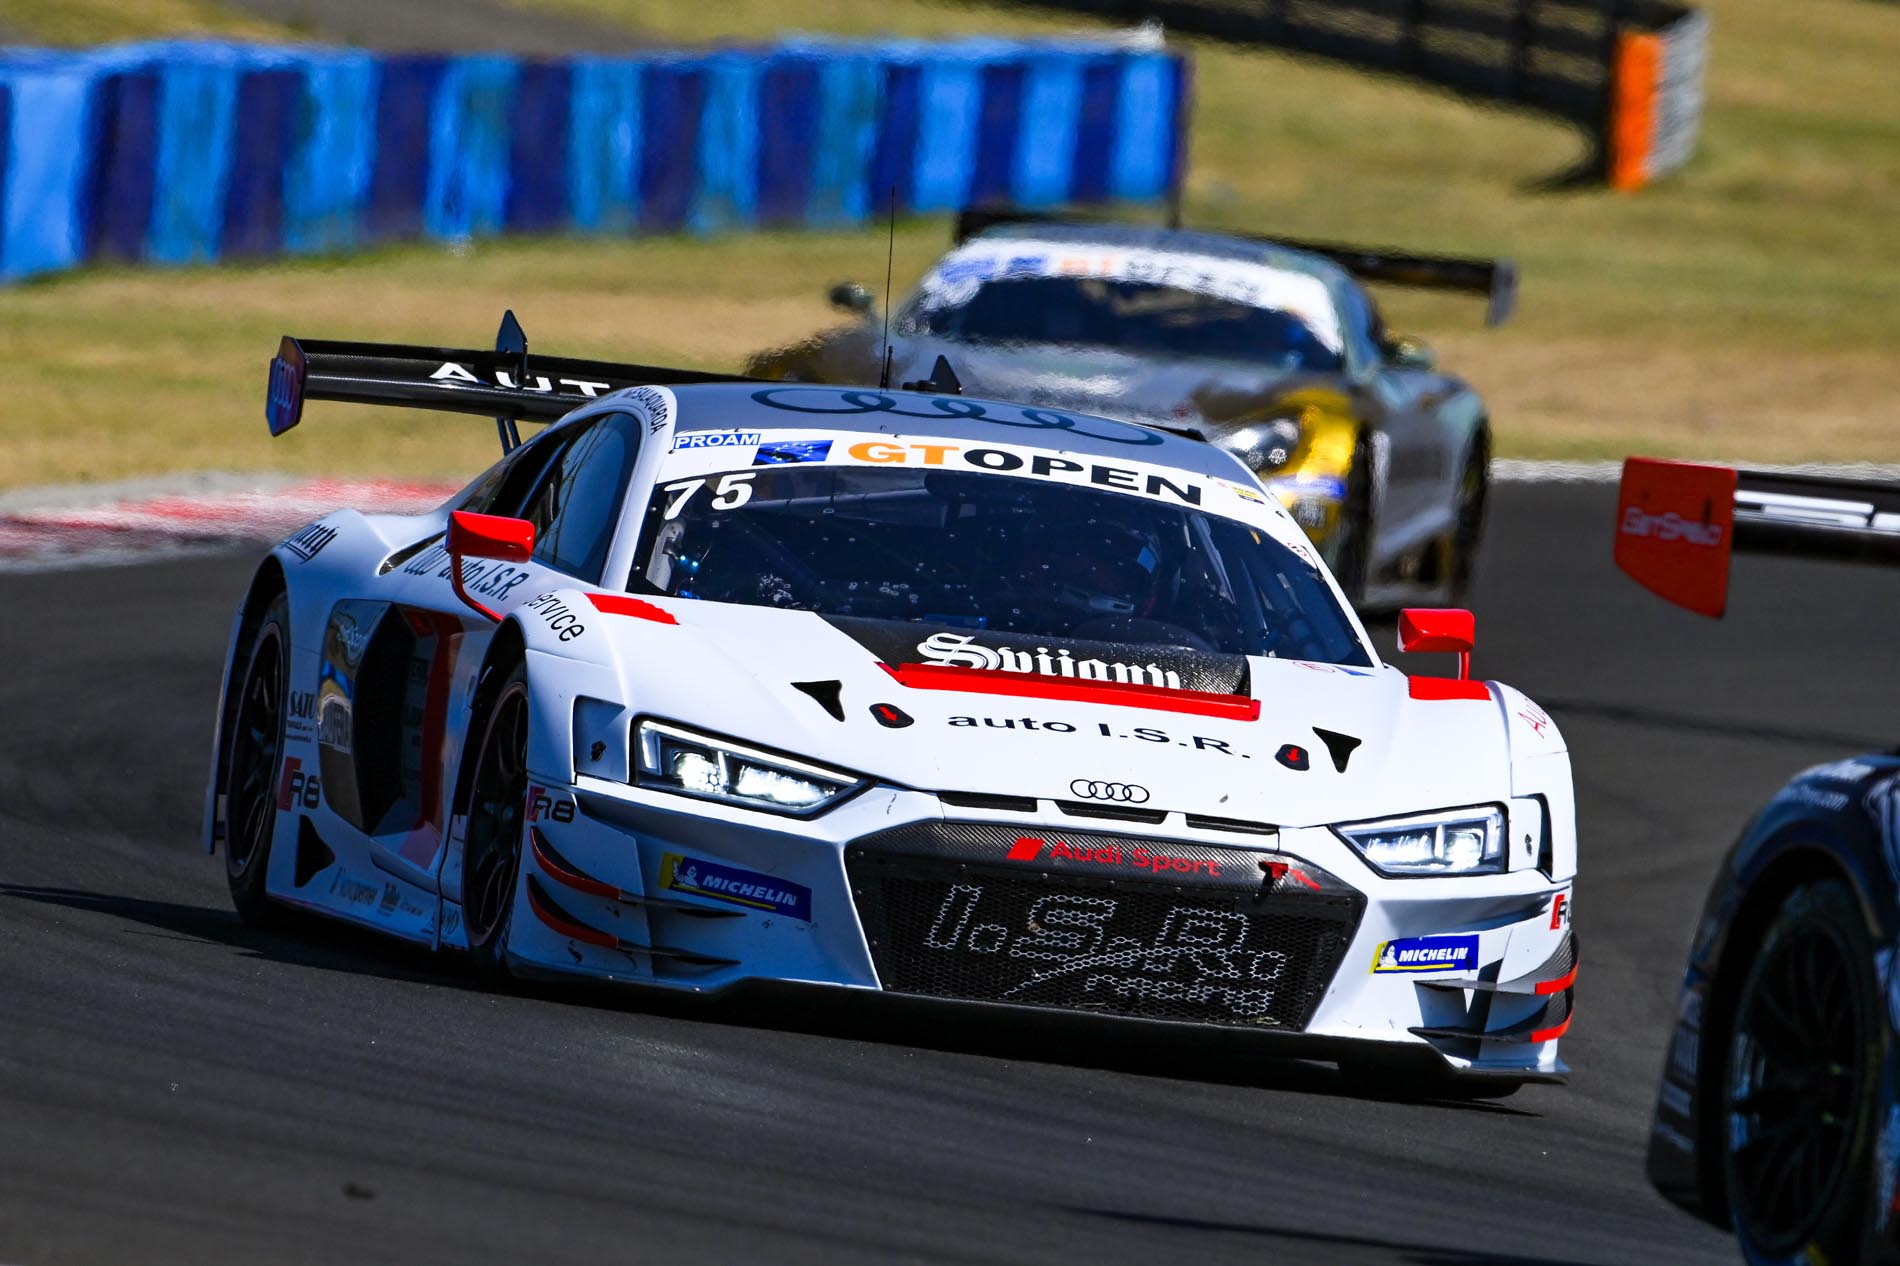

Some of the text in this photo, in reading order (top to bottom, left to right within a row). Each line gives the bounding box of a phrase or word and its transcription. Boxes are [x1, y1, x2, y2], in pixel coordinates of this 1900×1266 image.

[674, 433, 761, 449] PROAM
[663, 472, 757, 520] 75
[948, 715, 1251, 759] auto I.S.R.
[533, 796, 577, 824] R8
[1050, 840, 1222, 877] Audi Sport
[702, 874, 797, 907] MICHELIN
[1398, 946, 1468, 963] MICHELIN
